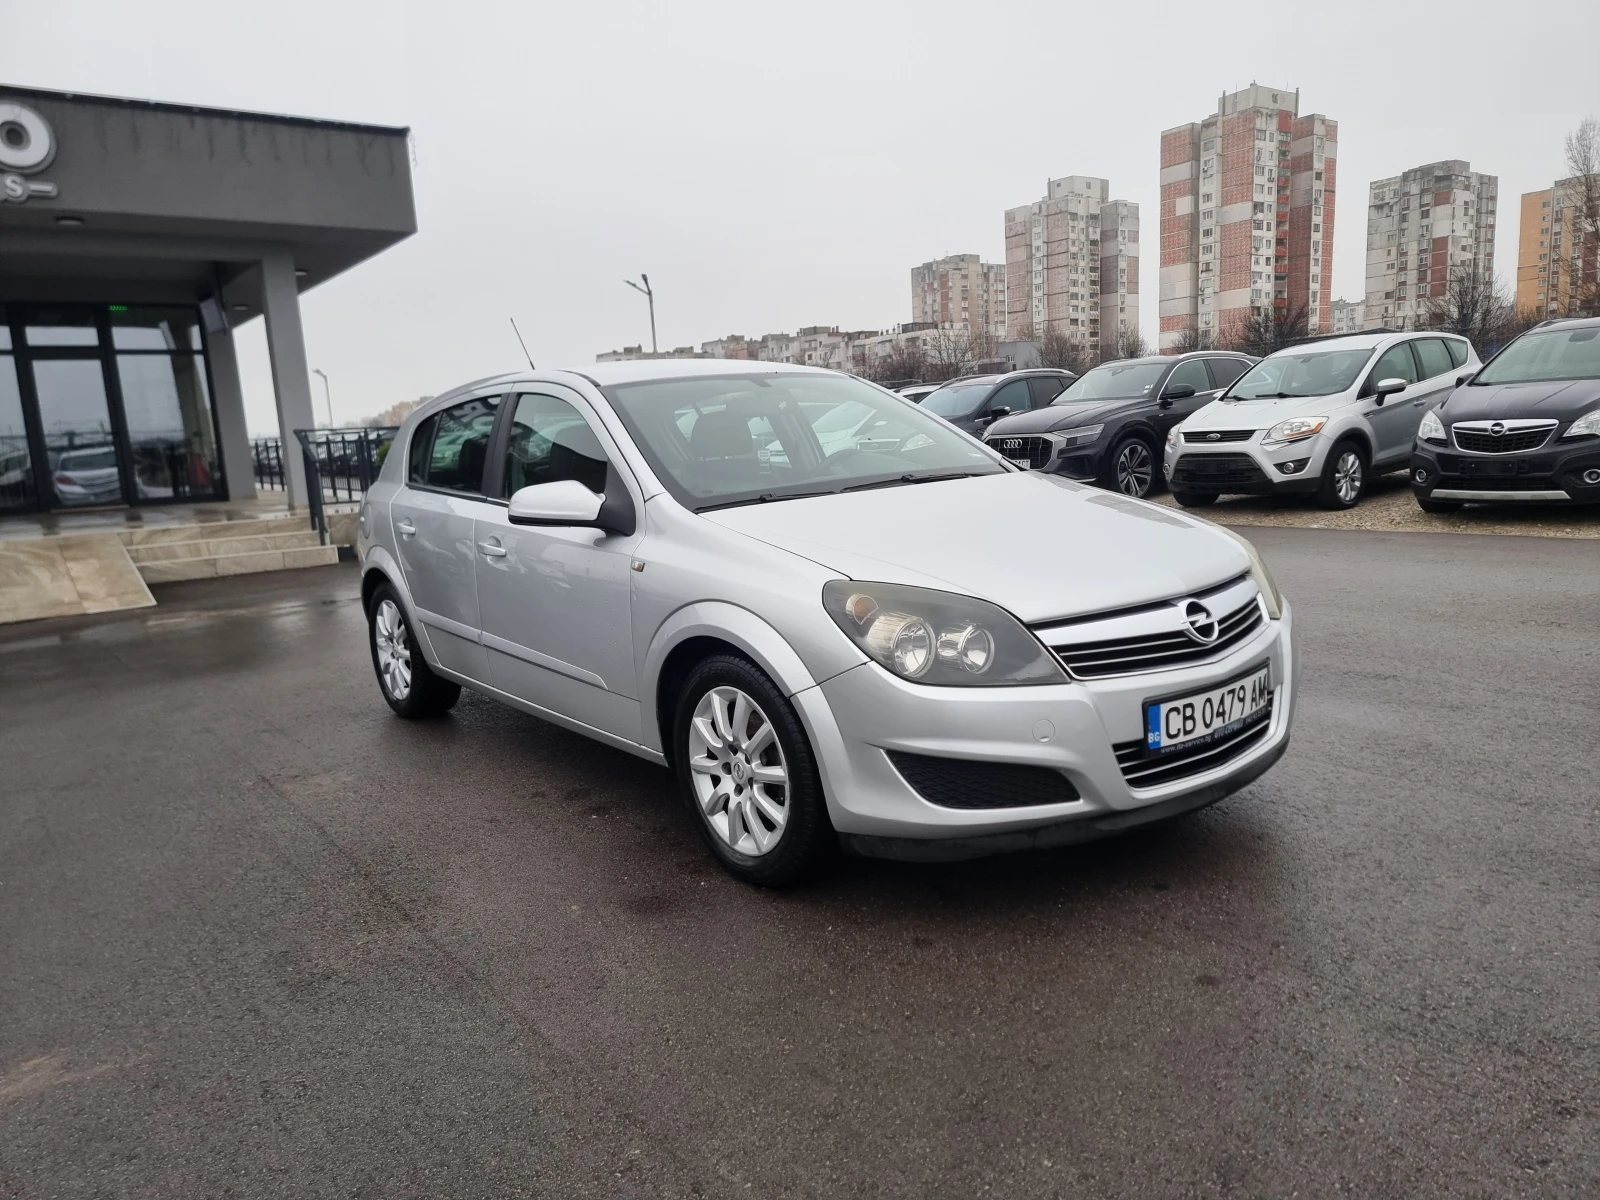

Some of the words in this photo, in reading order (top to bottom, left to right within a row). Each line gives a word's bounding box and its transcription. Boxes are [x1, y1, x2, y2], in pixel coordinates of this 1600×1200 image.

[1165, 702, 1196, 740] CB
[1202, 684, 1246, 729] 0479
[1148, 731, 1160, 743] BG
